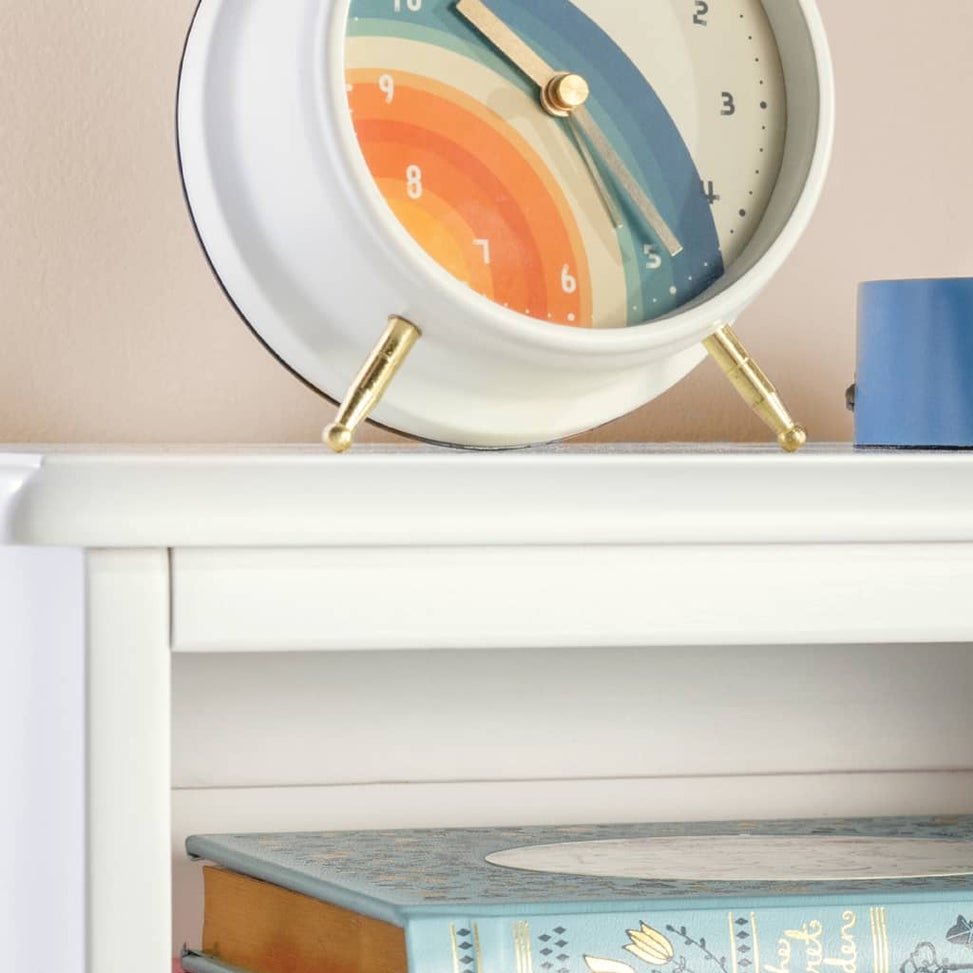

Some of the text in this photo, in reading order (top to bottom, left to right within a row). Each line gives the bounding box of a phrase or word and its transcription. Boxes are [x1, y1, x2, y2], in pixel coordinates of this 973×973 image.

[693, 0, 708, 26] 2
[379, 74, 394, 104] 9
[720, 91, 735, 116] 3
[406, 164, 422, 199] 8
[700, 180, 720, 204] 4
[472, 238, 490, 264] 7
[643, 243, 662, 269] 5
[561, 263, 576, 293] 6
